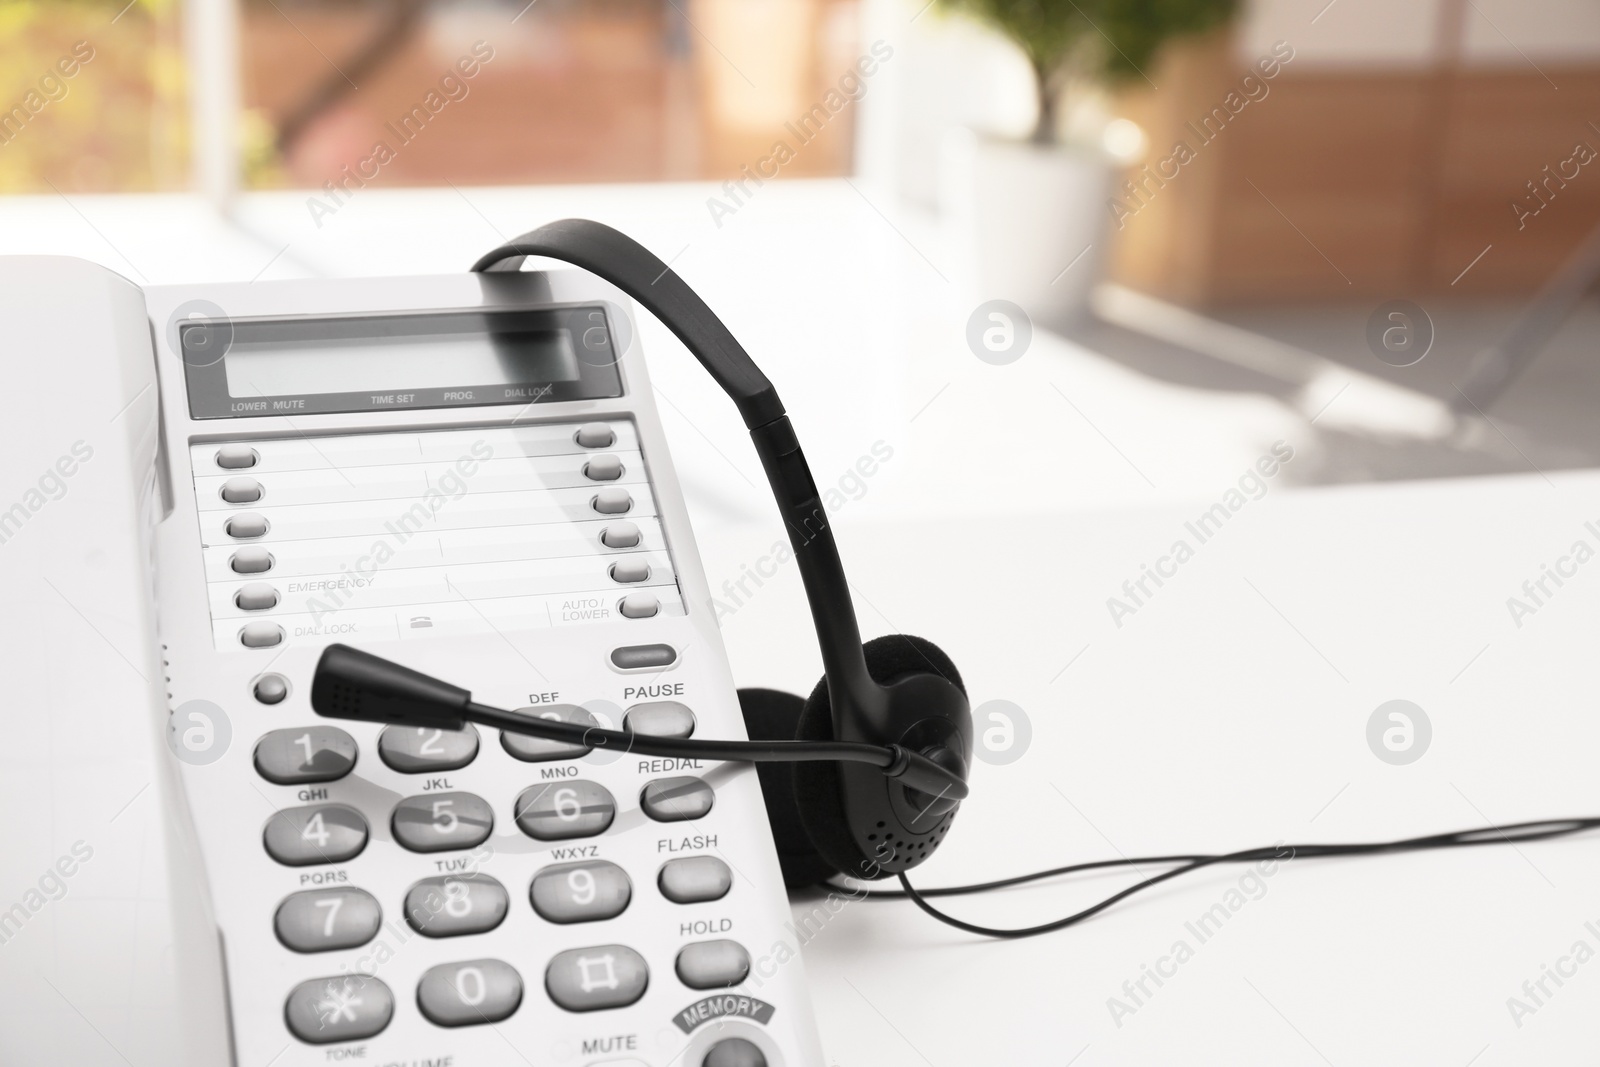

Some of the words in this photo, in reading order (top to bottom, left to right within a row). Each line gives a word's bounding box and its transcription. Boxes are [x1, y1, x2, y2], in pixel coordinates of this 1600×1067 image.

[371, 396, 394, 404] TIME
[397, 394, 415, 403] SET
[444, 391, 475, 401] PROG.
[505, 389, 526, 397] DIAL
[528, 387, 553, 396] LOCK
[231, 402, 267, 411] LOWER
[272, 400, 305, 410] MUTE
[288, 578, 374, 592] EMERGENCY
[563, 609, 610, 621] LOWER
[295, 626, 320, 637] DIAL
[529, 692, 560, 704] DEF
[624, 683, 684, 699] PAUSE
[417, 727, 444, 755] 2
[295, 733, 313, 766] 1
[541, 766, 579, 779] MNO
[638, 757, 703, 774] REDIAL
[423, 778, 453, 791] JKL
[298, 788, 328, 801] GHI
[553, 788, 581, 821] 6
[432, 800, 459, 834] 5
[301, 812, 330, 847] 4
[658, 834, 718, 853] FLASH
[551, 846, 599, 860] WXYZ
[435, 858, 469, 872] TUV
[299, 870, 348, 885] PQRS
[567, 868, 596, 905] 9
[445, 881, 473, 918] 8
[315, 898, 343, 937] 7
[679, 918, 733, 936] HOLD
[455, 966, 486, 1006] 0
[682, 997, 763, 1028] MEMORY
[581, 1034, 637, 1055] MUTE
[325, 1045, 368, 1061] TONE
